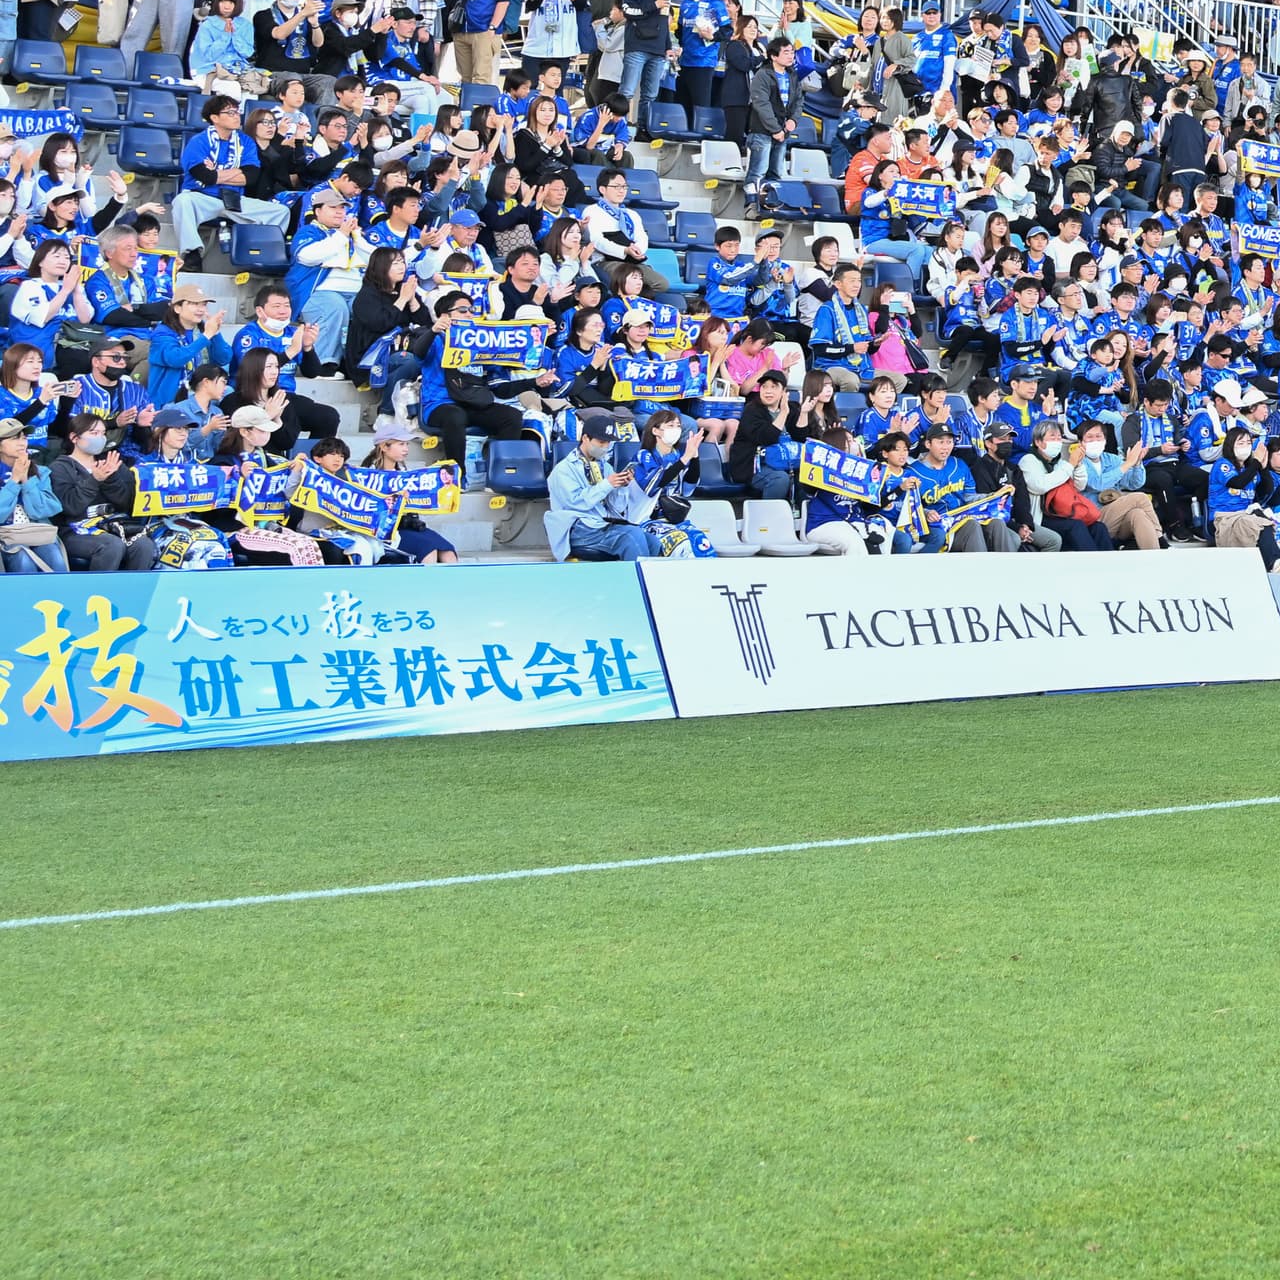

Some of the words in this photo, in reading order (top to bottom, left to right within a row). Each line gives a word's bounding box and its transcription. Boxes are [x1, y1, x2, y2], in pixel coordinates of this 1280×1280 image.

[451, 349, 464, 366] 15
[626, 361, 657, 380] 梅木
[153, 466, 185, 490] 梅木
[388, 472, 437, 492] 小太郎
[807, 467, 814, 481] 6
[164, 493, 188, 505] BEYOND
[188, 491, 215, 504] STANDARD
[293, 490, 310, 507] 11
[308, 472, 379, 513] TANQUE
[143, 493, 151, 512] 2
[341, 508, 373, 524] STANDARD
[806, 602, 1085, 651] TACHIBANA
[1101, 596, 1235, 636] KAIUN
[15, 594, 183, 732] 技
[171, 636, 648, 719] 研工業株式会社
